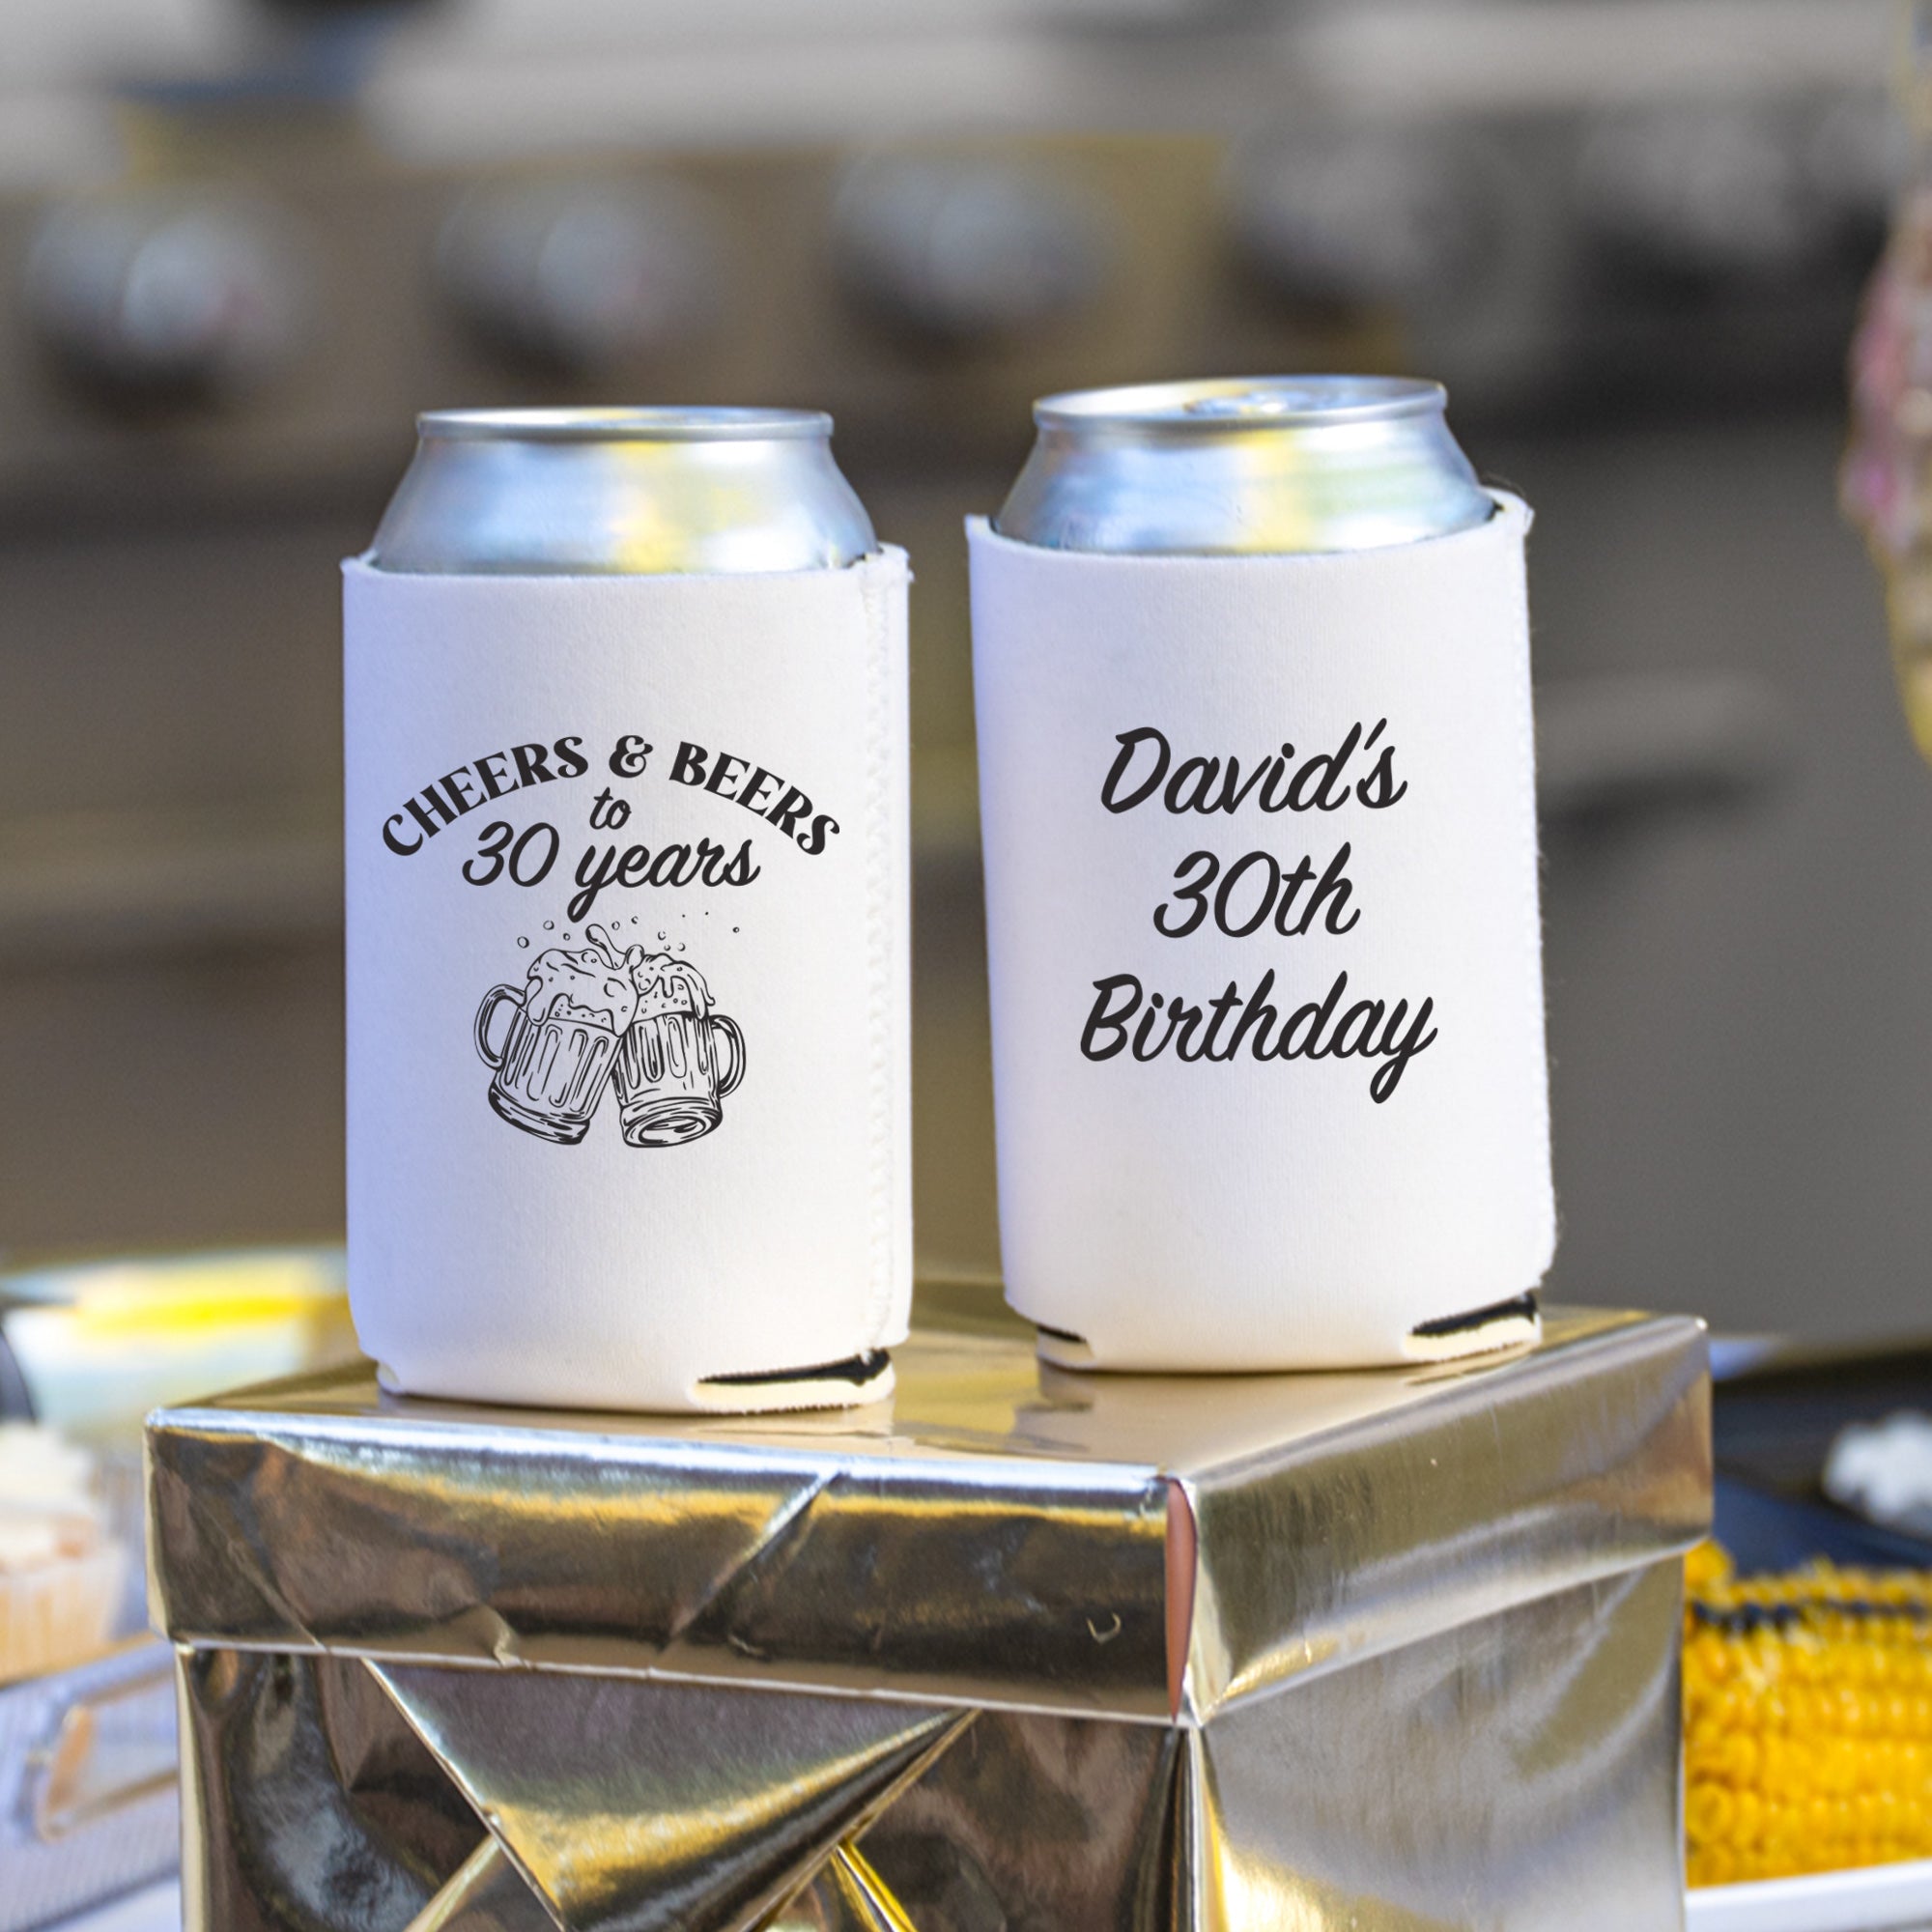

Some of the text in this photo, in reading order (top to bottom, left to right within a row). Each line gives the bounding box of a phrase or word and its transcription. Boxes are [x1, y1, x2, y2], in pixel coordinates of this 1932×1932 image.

[382, 734, 840, 857] CHEERS & BEERS
[588, 786, 632, 831] to
[1100, 717, 1408, 815] David's
[461, 820, 761, 923] 30 years
[1152, 841, 1361, 939] 30th
[1080, 968, 1438, 1104] Birthday
